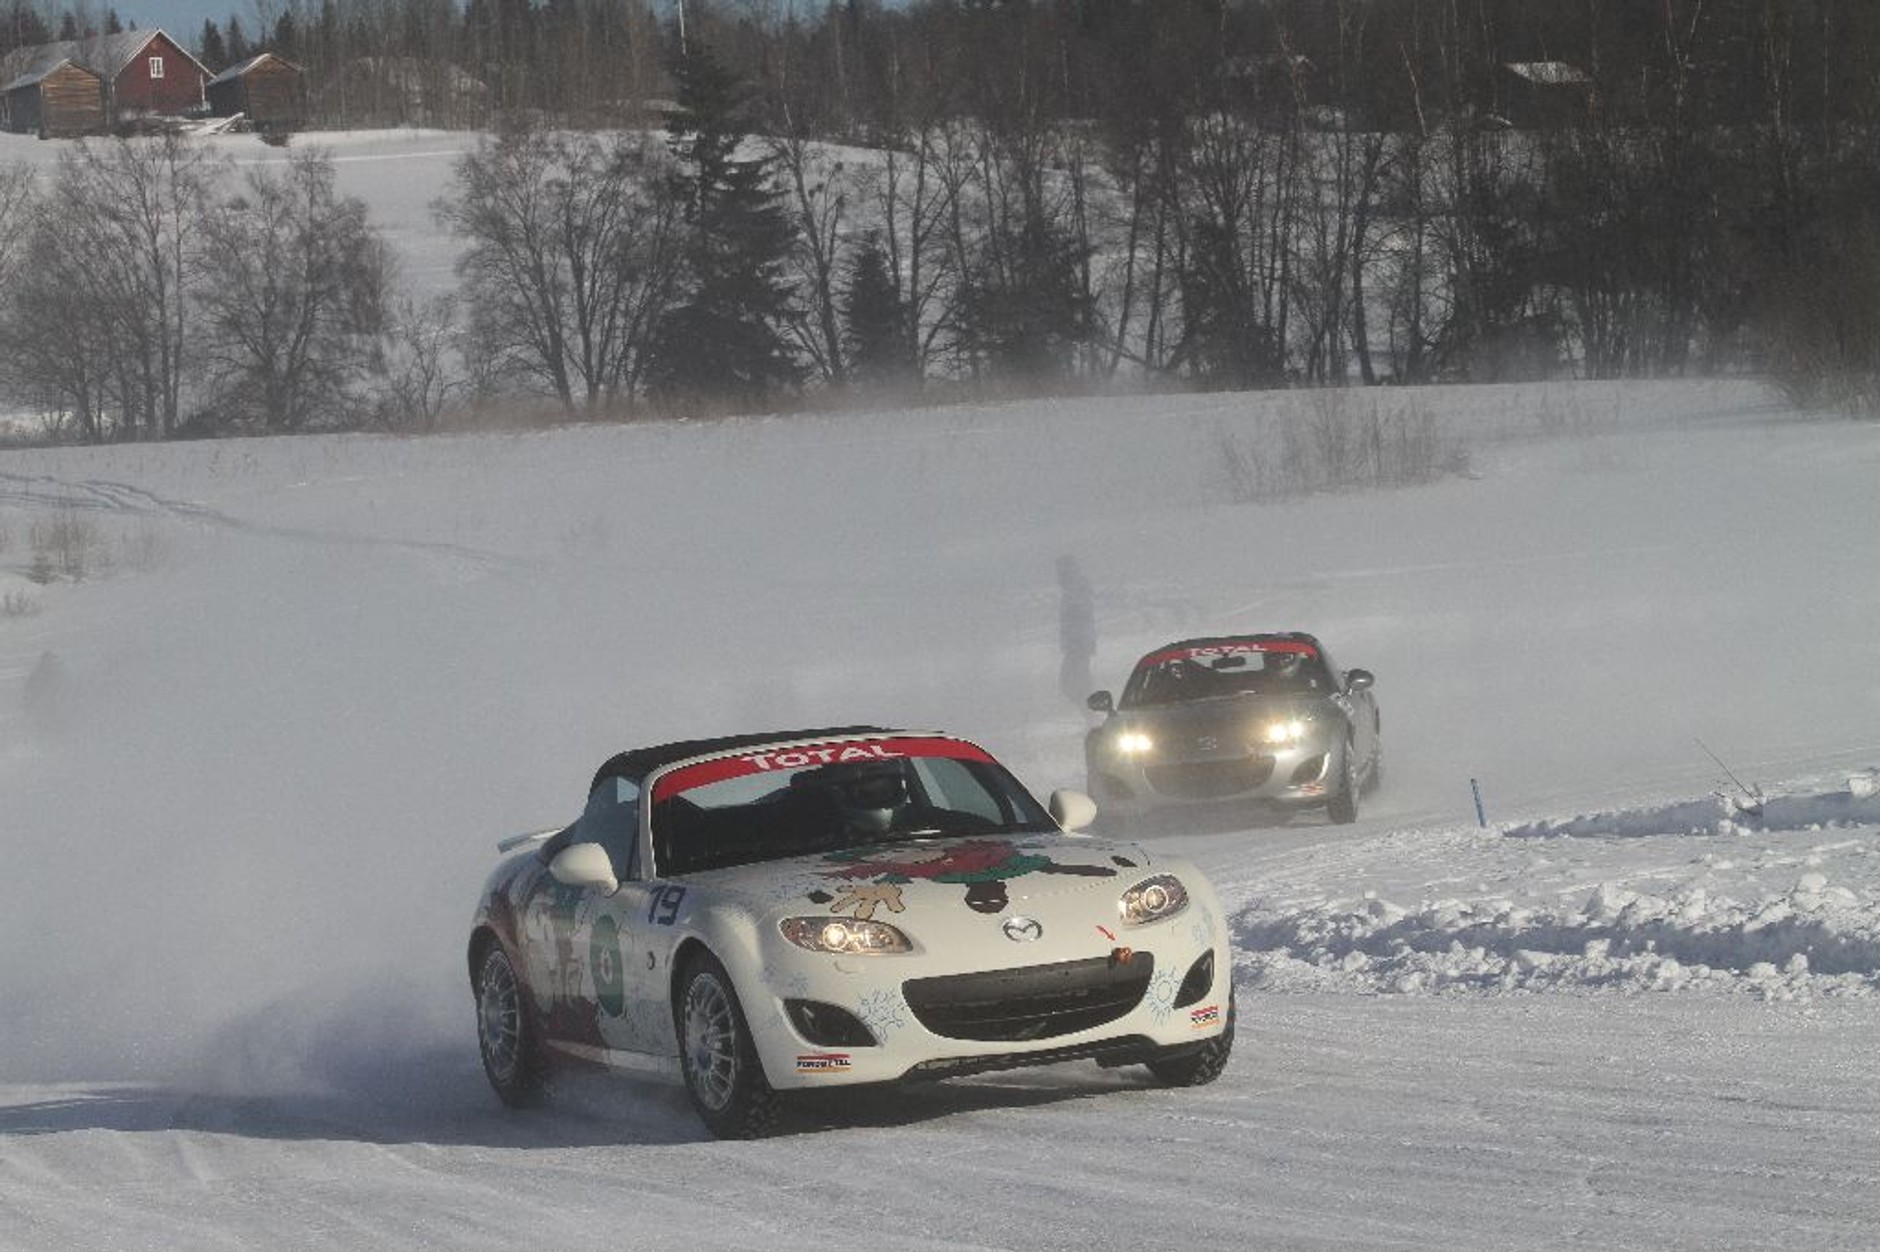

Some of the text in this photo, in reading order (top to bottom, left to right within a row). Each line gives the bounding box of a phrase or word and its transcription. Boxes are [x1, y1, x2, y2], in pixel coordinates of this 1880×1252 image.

[1190, 644, 1266, 657] TOTAL
[744, 744, 904, 770] TOTAL
[648, 884, 687, 926] 19
